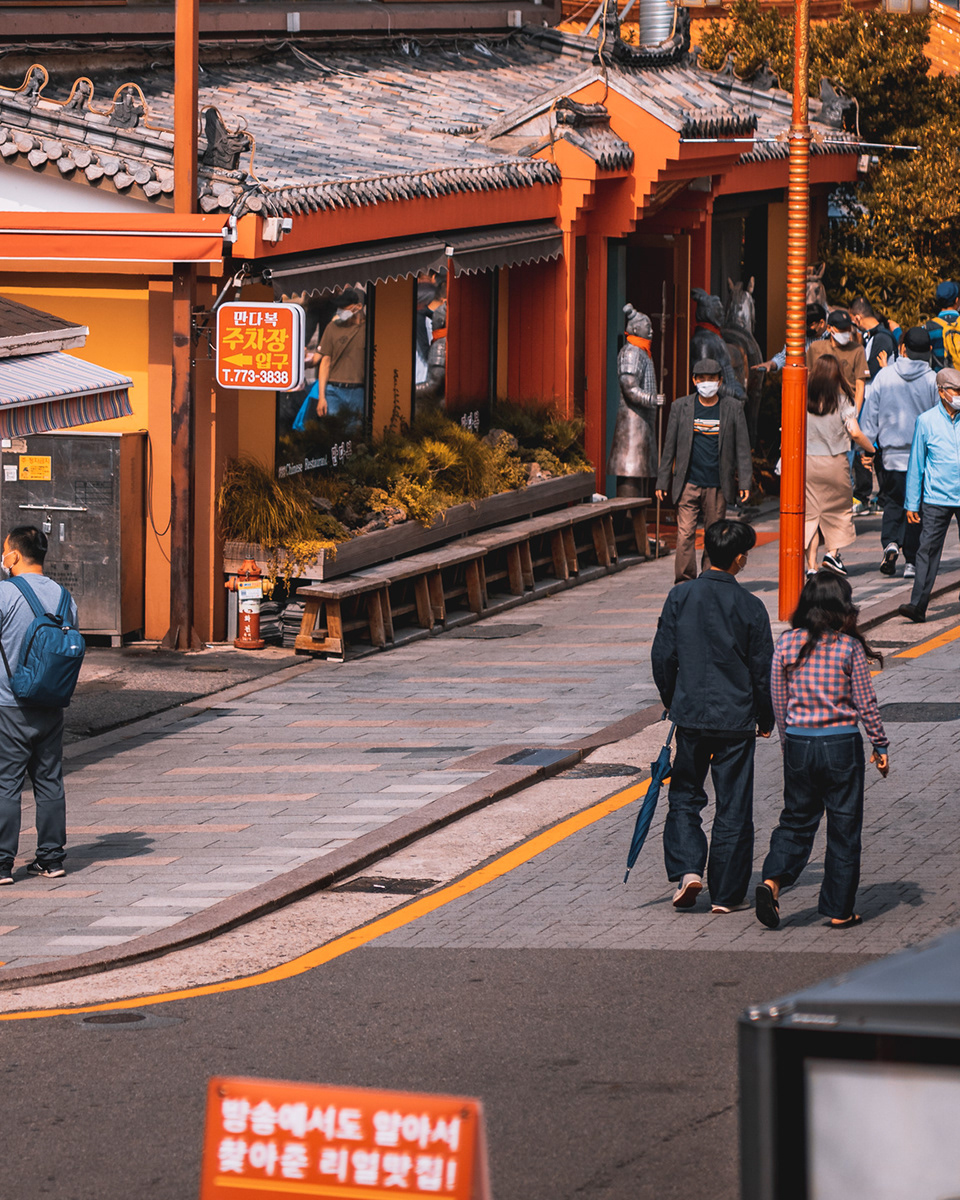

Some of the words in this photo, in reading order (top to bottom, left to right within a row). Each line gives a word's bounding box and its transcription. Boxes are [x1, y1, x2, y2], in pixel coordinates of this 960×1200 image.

[233, 310, 279, 328] 만다복
[222, 327, 289, 353] 주차장
[255, 352, 289, 370] 입구
[222, 368, 289, 384] T.773-3838
[220, 1097, 365, 1141] 방송에서도
[318, 1145, 458, 1192] 리얼맛집!
